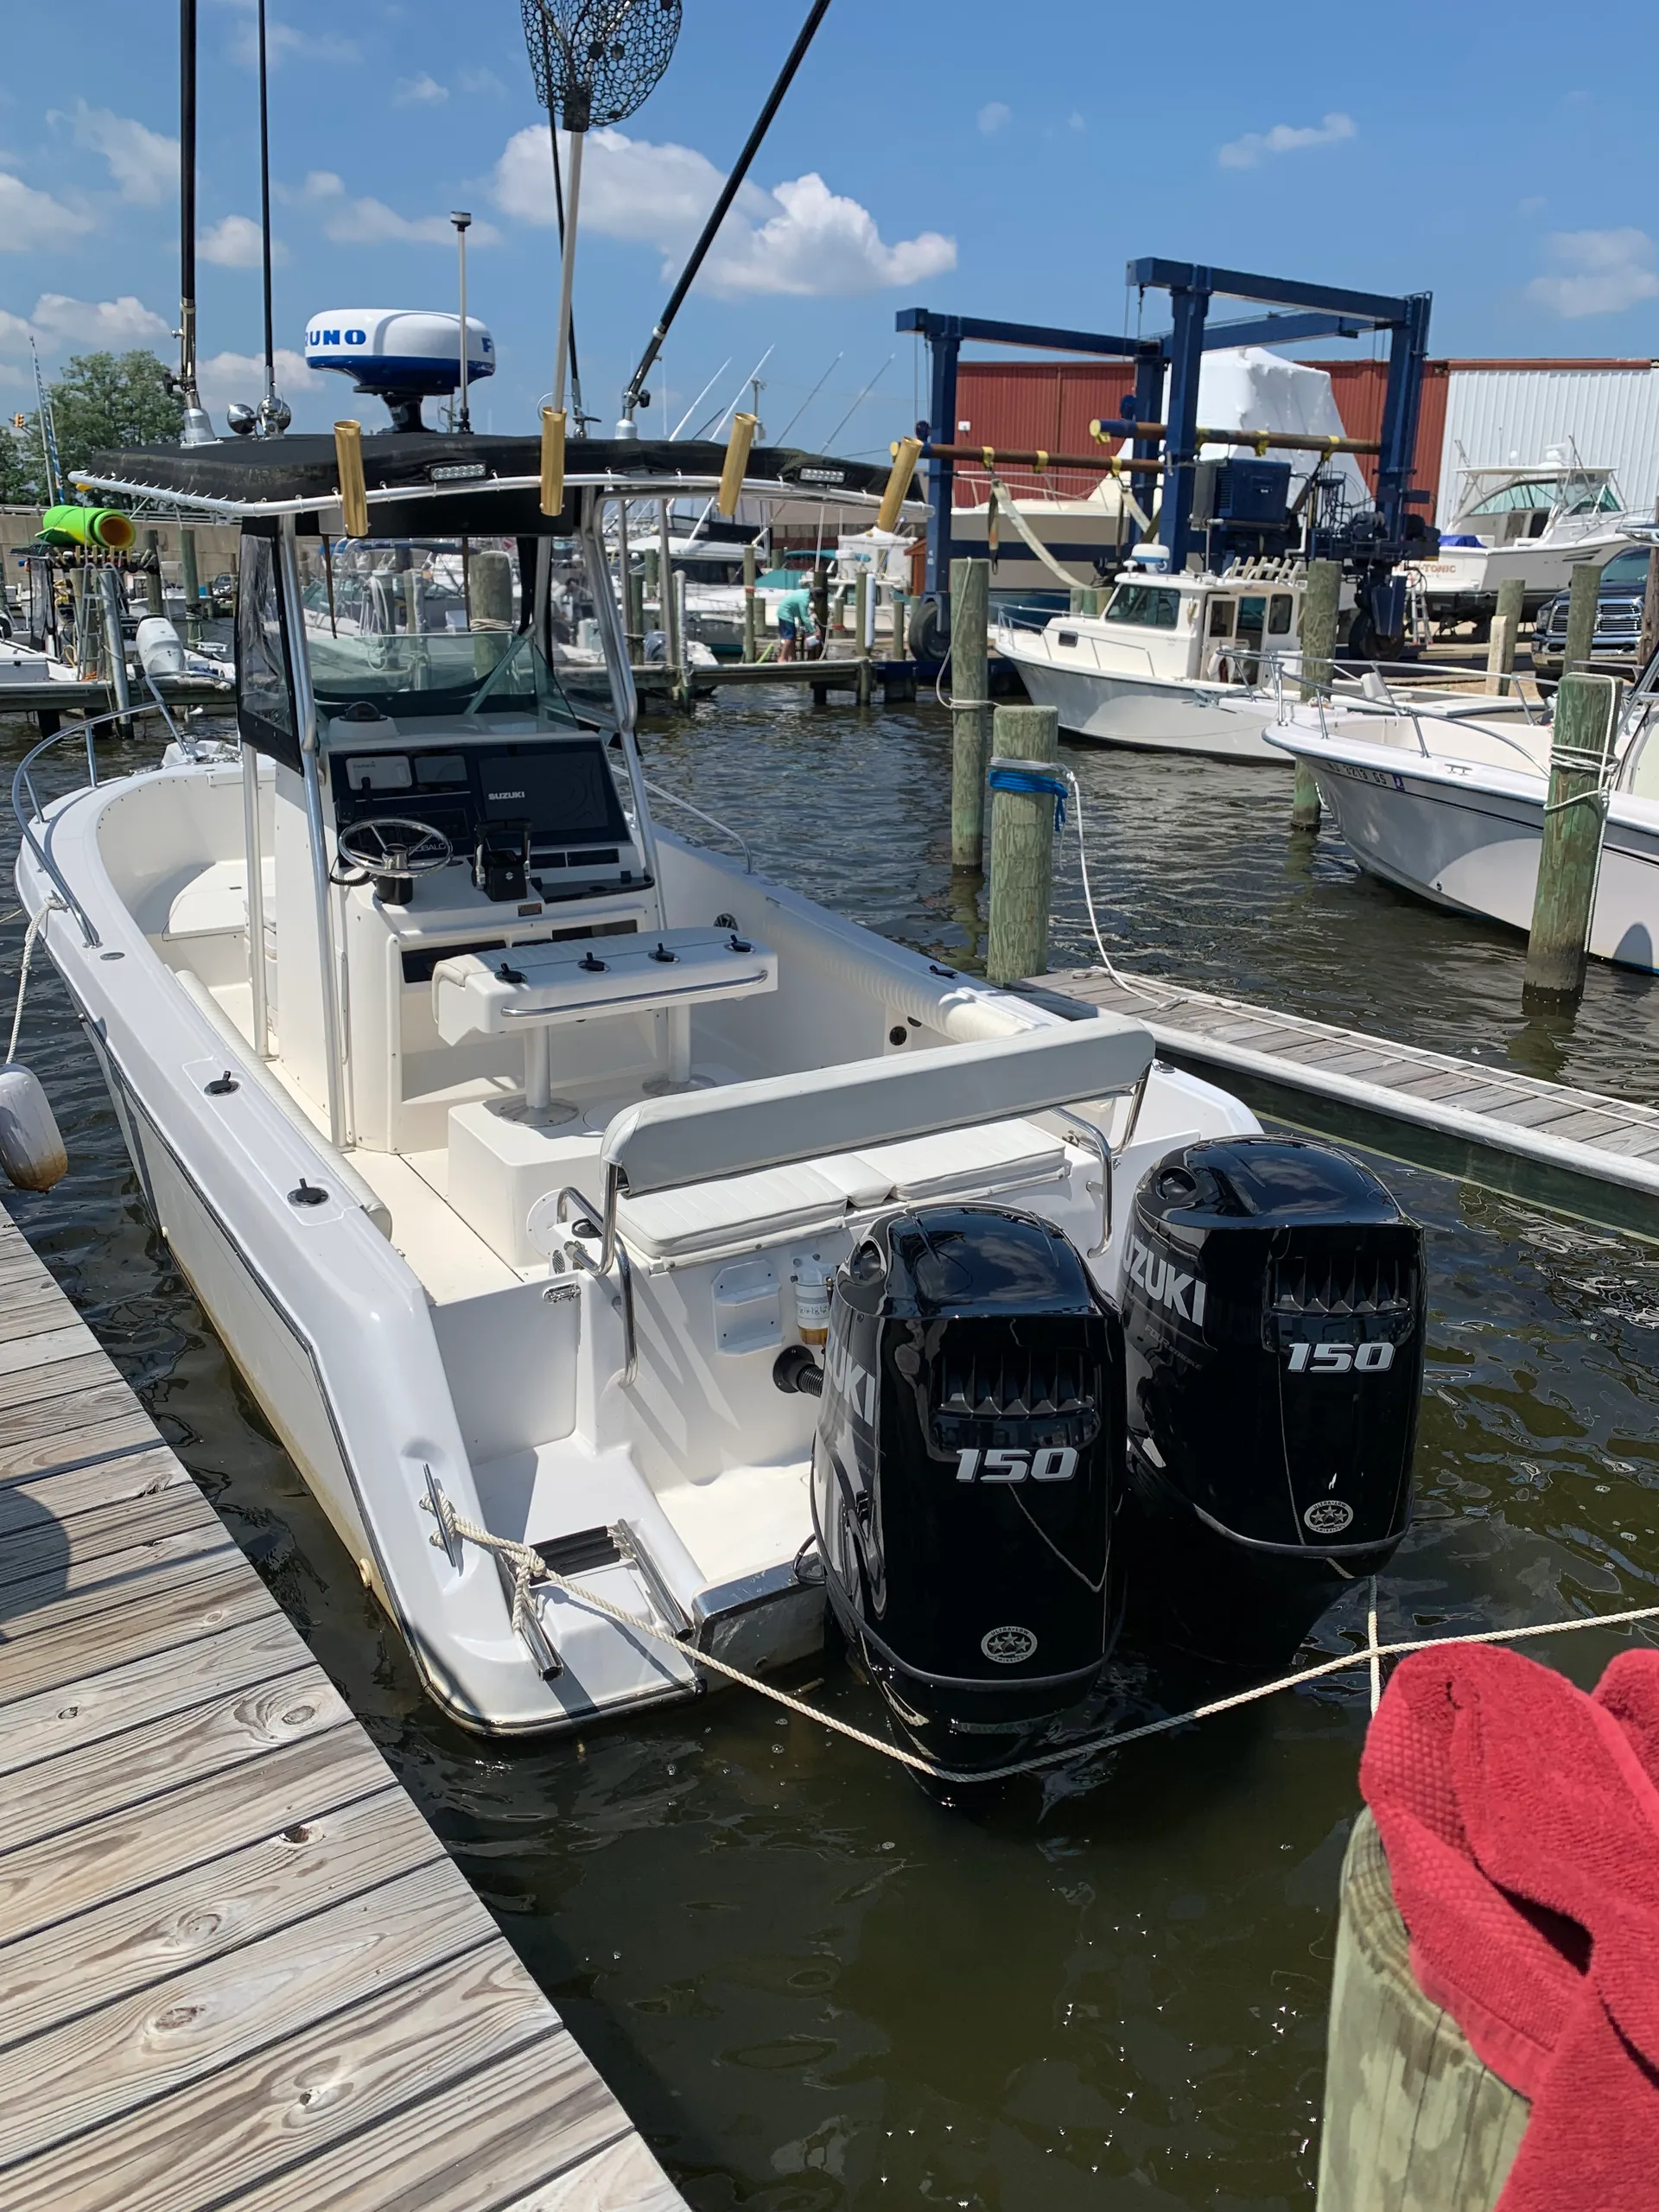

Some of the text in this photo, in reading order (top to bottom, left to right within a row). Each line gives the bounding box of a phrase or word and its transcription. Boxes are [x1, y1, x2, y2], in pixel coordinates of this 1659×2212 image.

[488, 791, 525, 800] SUZUKI
[1123, 1230, 1207, 1327] UZUKI
[1287, 1342, 1395, 1373] 150
[956, 1446, 1079, 1484] 150
